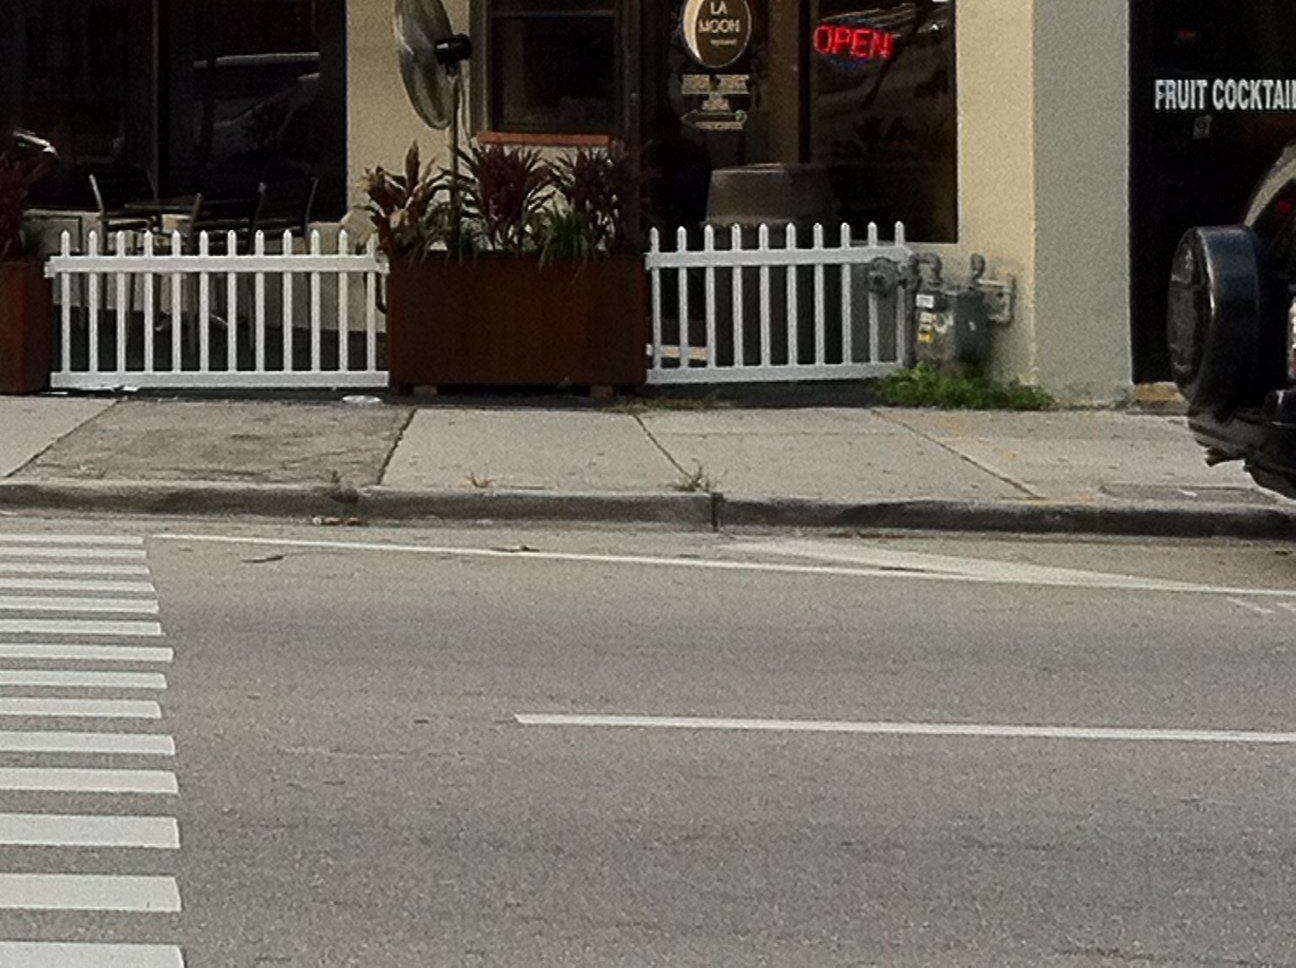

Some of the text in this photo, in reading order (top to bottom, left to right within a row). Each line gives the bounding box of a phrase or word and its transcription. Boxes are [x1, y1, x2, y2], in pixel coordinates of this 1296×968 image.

[709, 0, 728, 15] LA
[698, 18, 740, 34] MOON
[813, 24, 893, 59] OPEN
[1154, 79, 1208, 111] FRUIT
